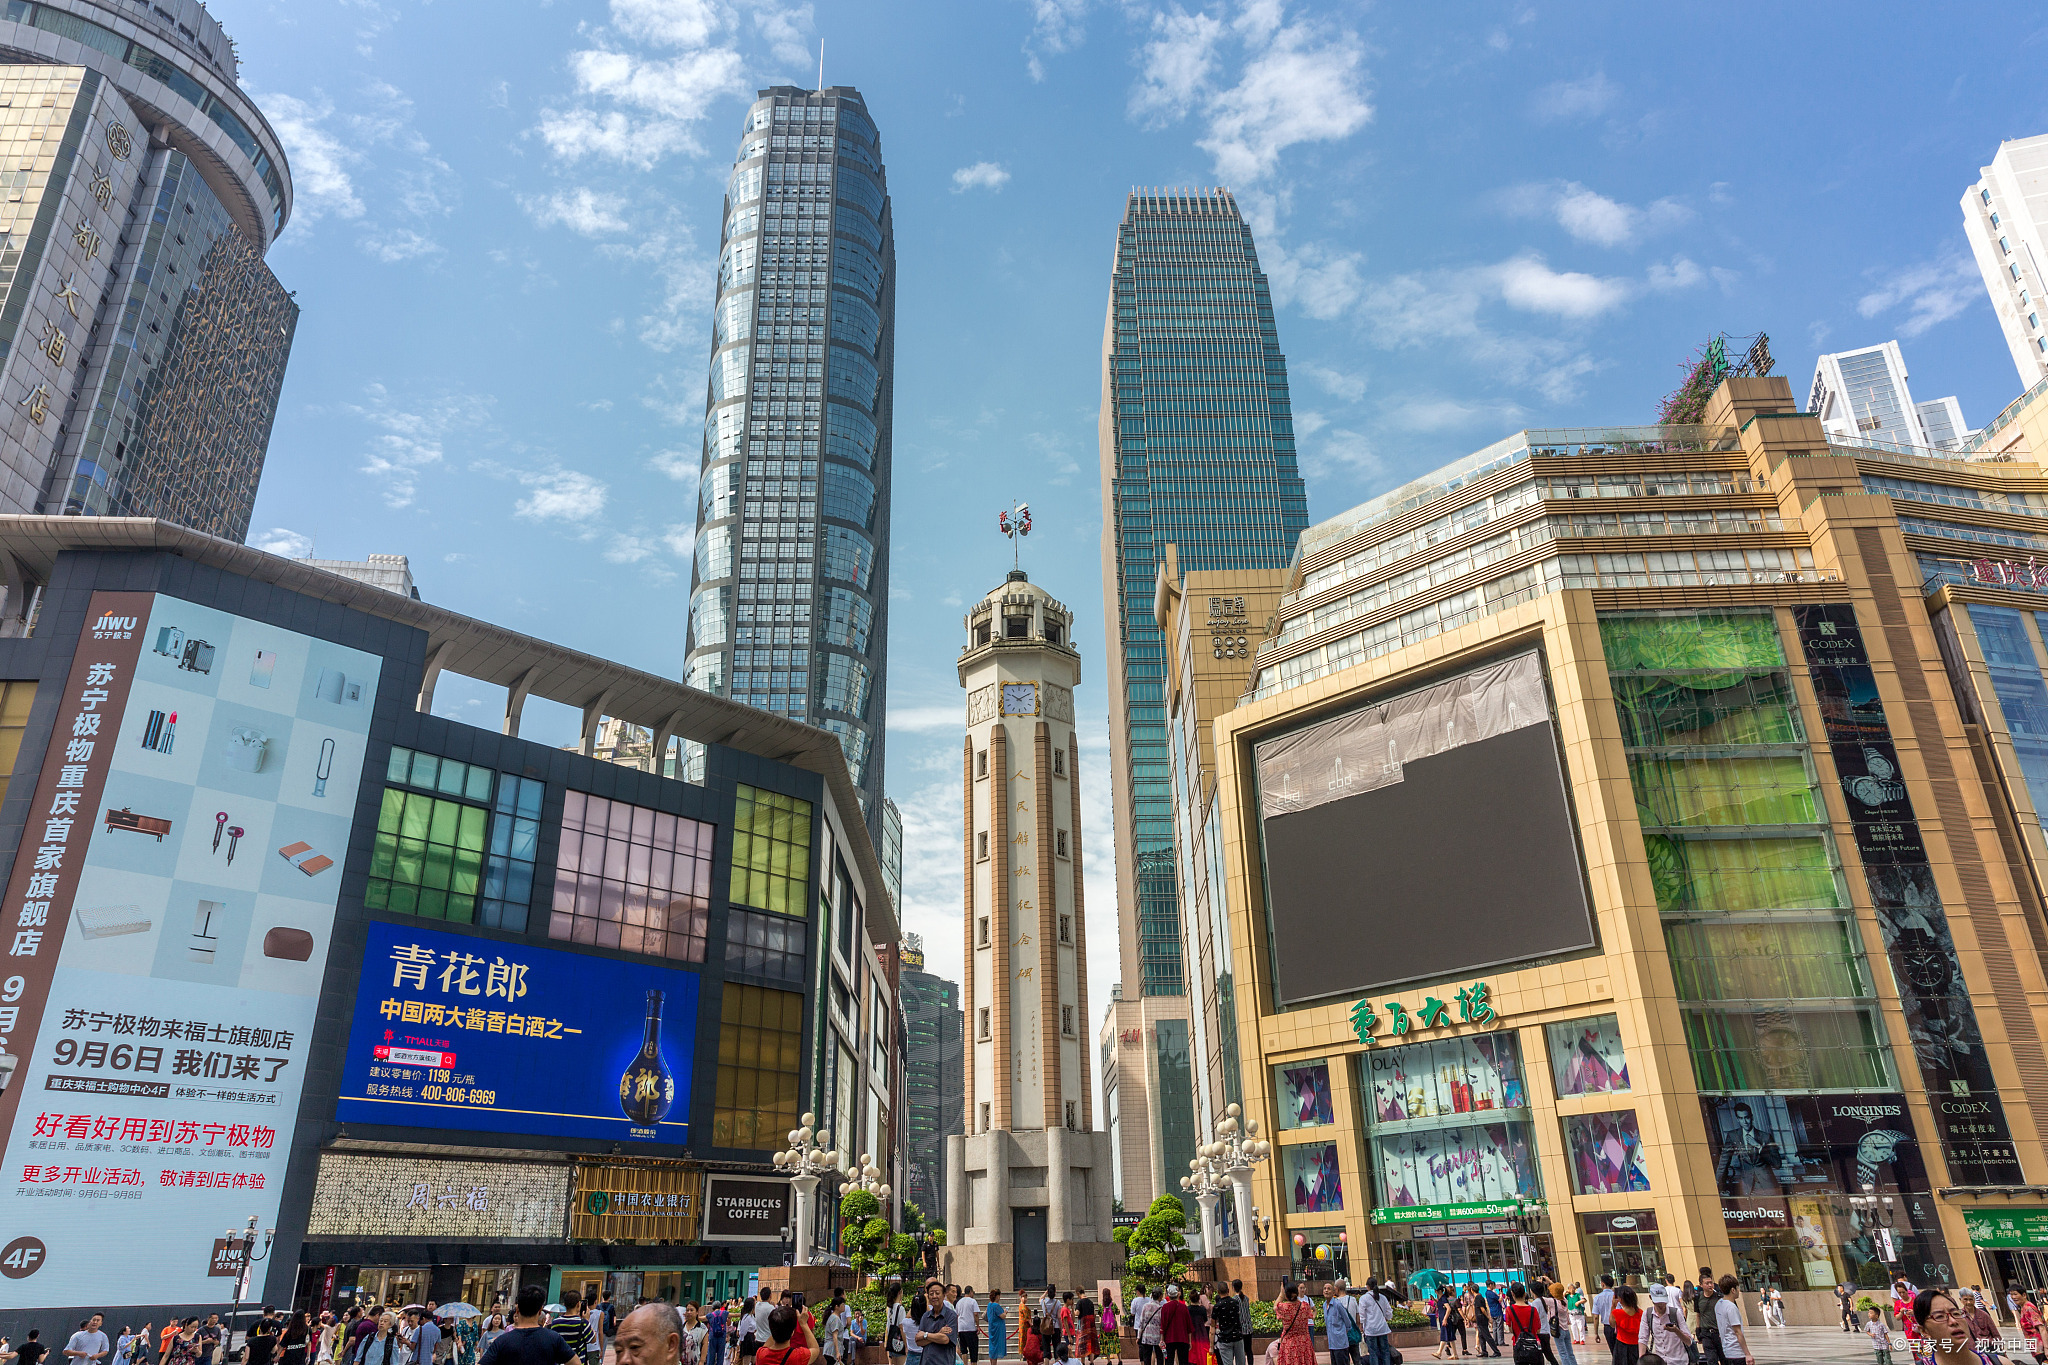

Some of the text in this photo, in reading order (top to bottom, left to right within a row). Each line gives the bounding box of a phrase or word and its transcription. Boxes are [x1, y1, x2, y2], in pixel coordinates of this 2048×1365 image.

[19, 165, 115, 426] 渝都大酒店
[92, 610, 138, 630] JIWU
[93, 631, 132, 640] 苏宁极物
[9, 662, 117, 957] 苏宁极物重庆首家旗舰店
[1009, 769, 1034, 982] 人民解放纪念碑
[389, 943, 530, 1003] 青花郎
[380, 997, 583, 1040] 中国两大酱香白酒之一
[1348, 981, 1497, 1046] 重百大楼
[62, 1008, 295, 1050] 苏宁极物来福士旗舰店
[52, 1038, 290, 1082] 9月6日 我们来了
[1372, 1055, 1406, 1071] OLAY
[428, 1068, 451, 1083] 1198
[174, 1086, 277, 1104] 体验不一样的生活方式
[421, 1084, 496, 1105] 400-806-6969
[1832, 1105, 1902, 1117] LONGINES
[32, 1111, 276, 1149] 好看好用到苏宁极物
[160, 1169, 266, 1189] 敬请到店体验
[406, 1183, 489, 1212] 周六福
[614, 1192, 691, 1208] 中国农业银行
[716, 1196, 782, 1209] STARBUCKS
[728, 1209, 769, 1219] COFFEE
[3, 1248, 42, 1269] 4F
